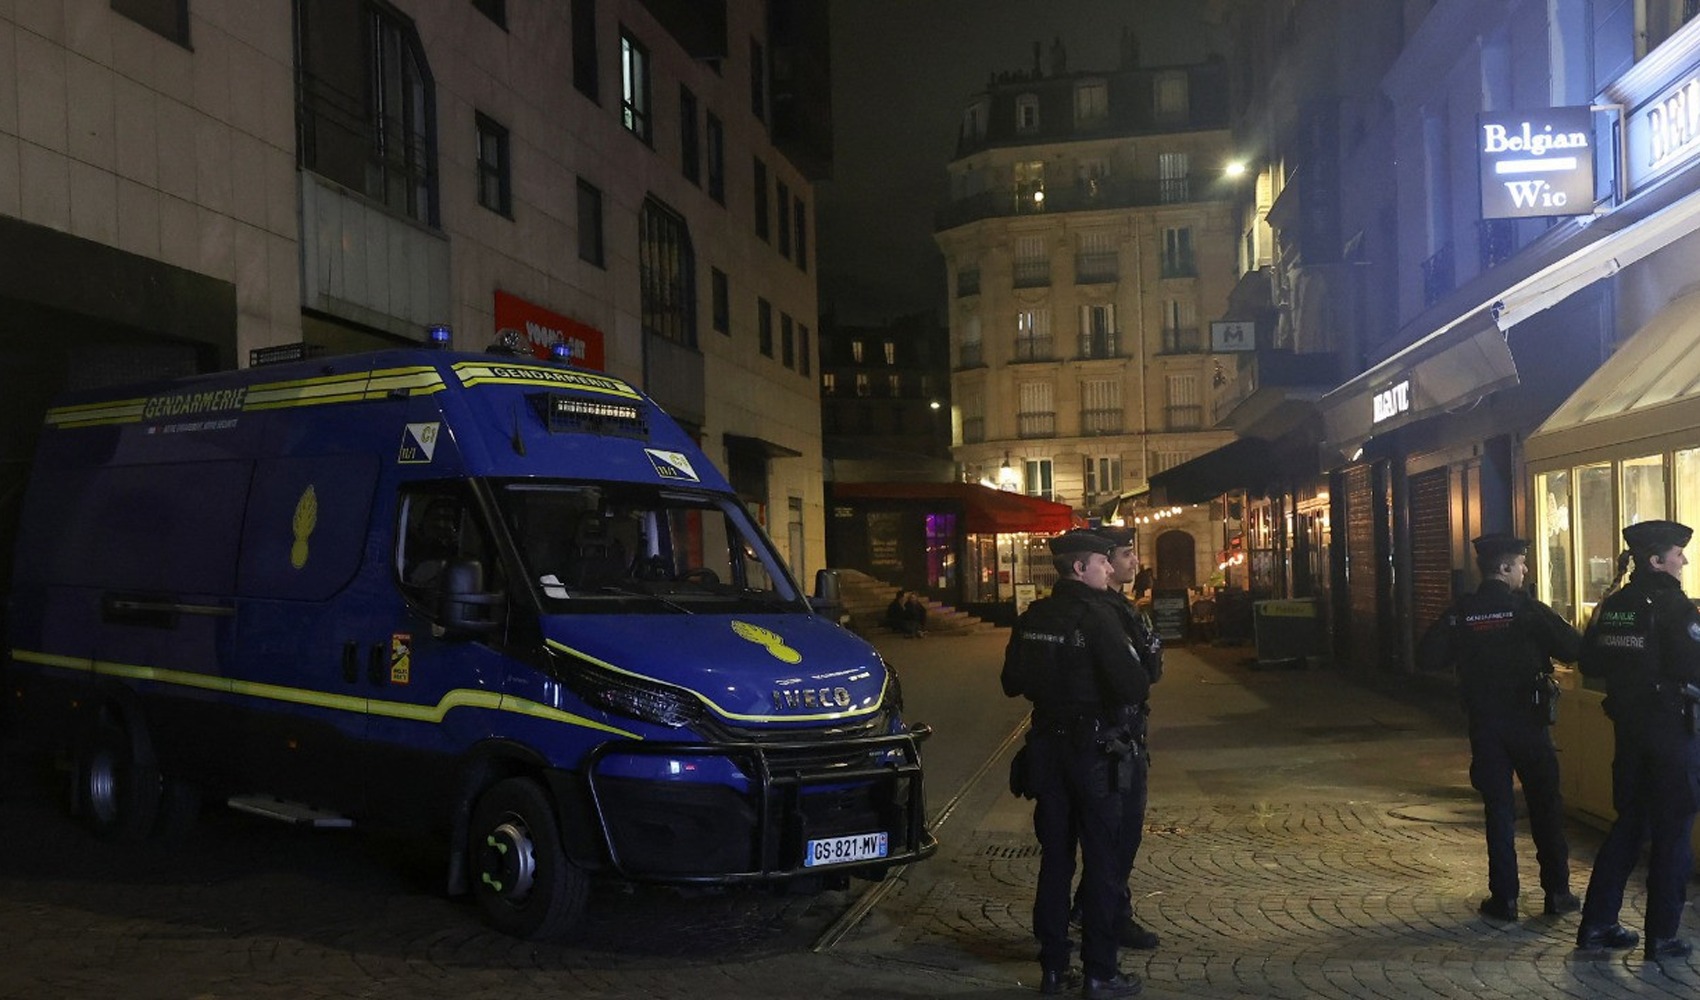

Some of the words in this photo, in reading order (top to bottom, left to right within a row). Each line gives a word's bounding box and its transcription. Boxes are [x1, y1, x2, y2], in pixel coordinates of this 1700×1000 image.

[1483, 122, 1588, 155] Belgian
[1504, 180, 1567, 209] Wic
[493, 367, 617, 390] GENDARMERIE
[145, 388, 247, 418] GENDARMERIE
[772, 686, 850, 711] IVECO
